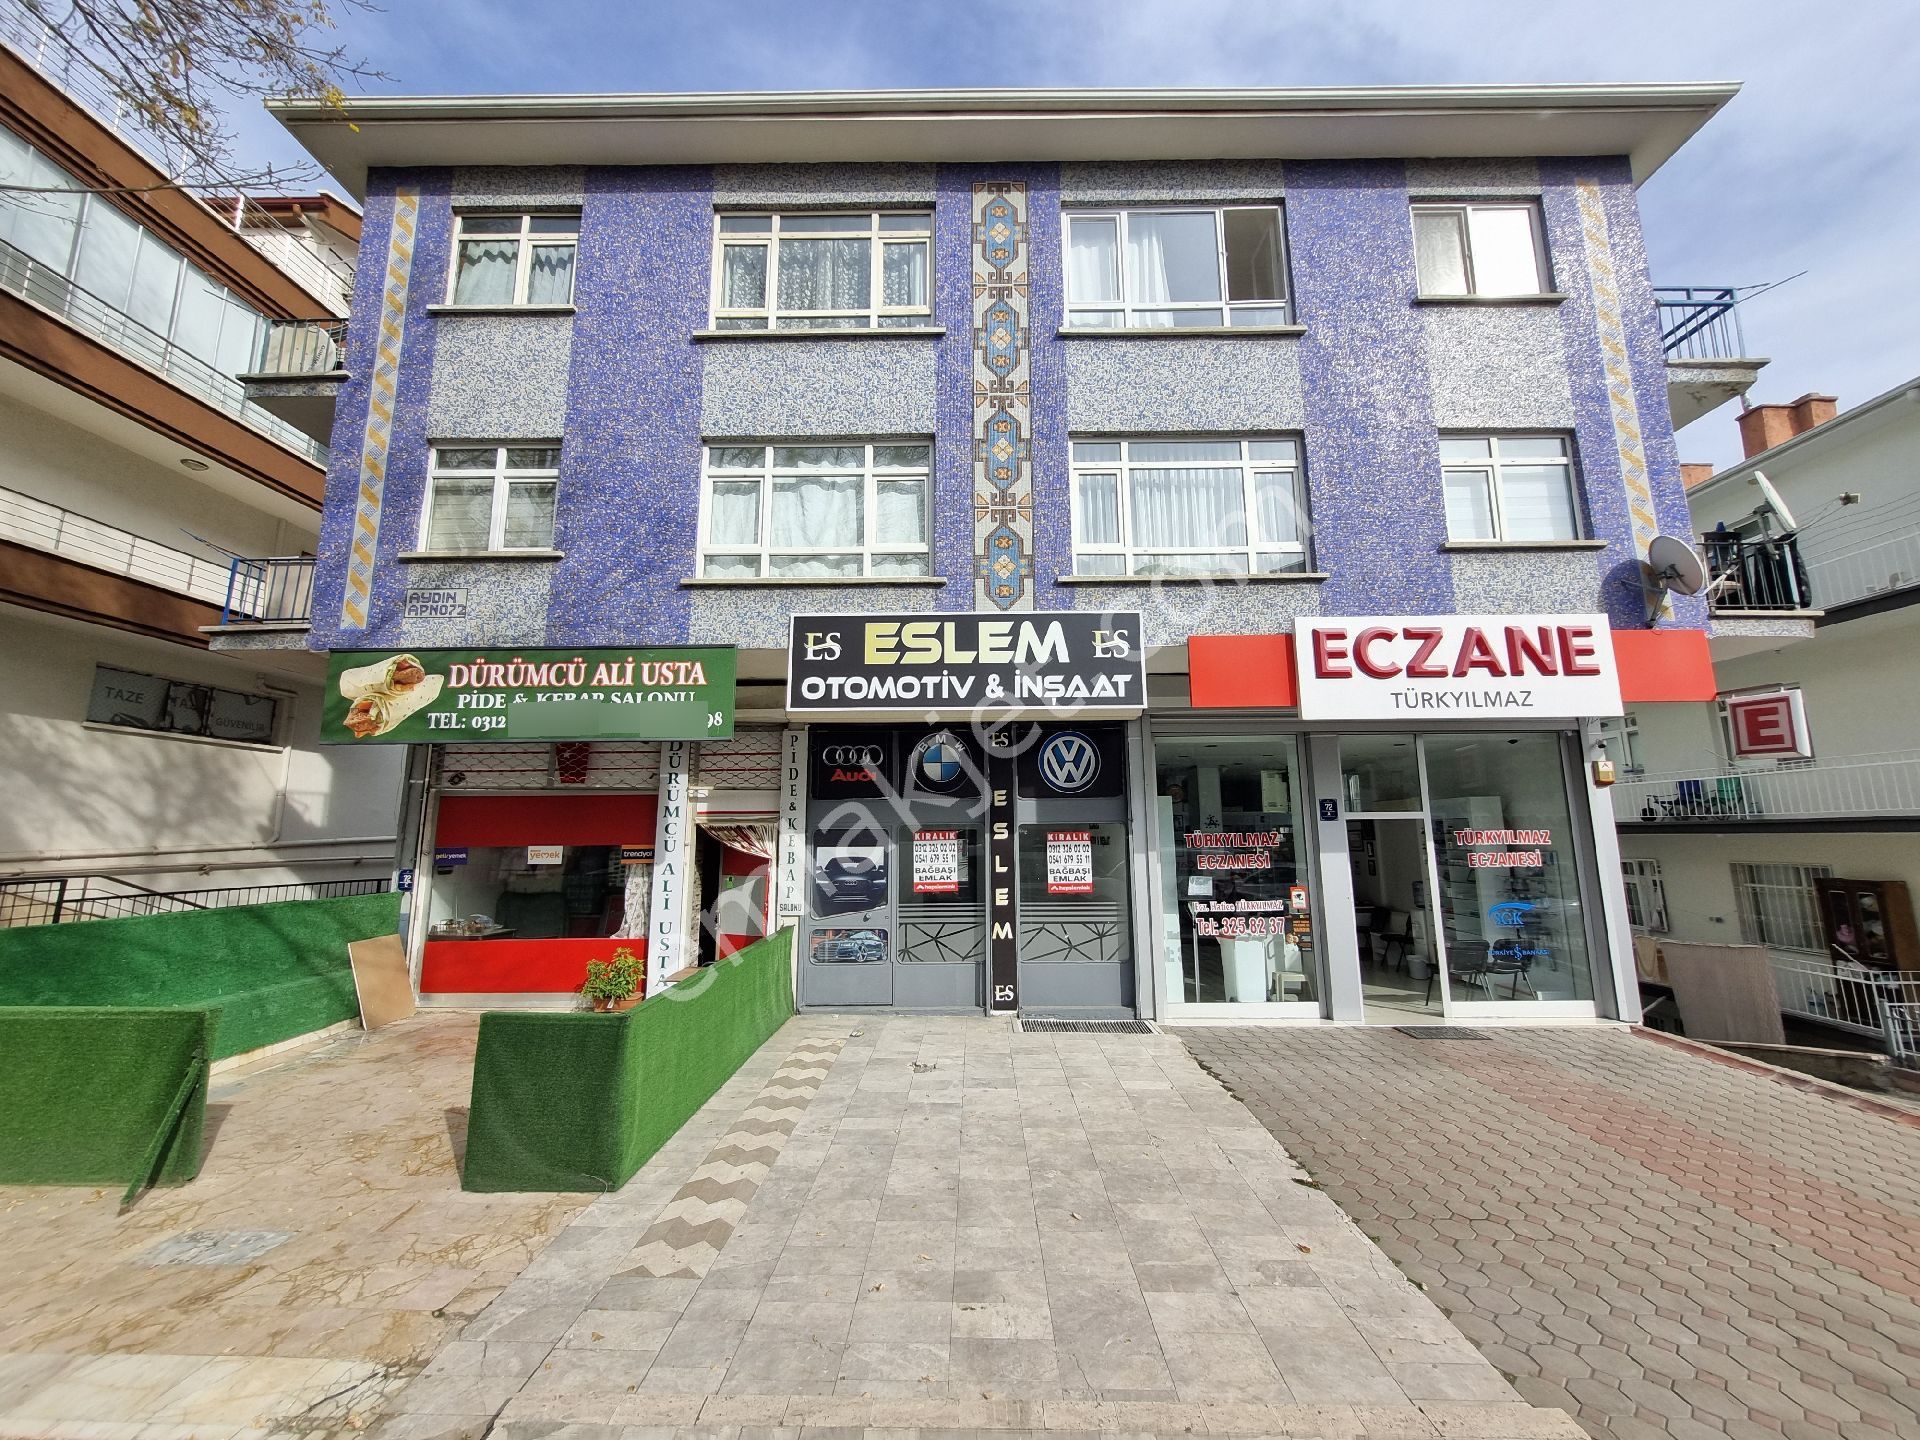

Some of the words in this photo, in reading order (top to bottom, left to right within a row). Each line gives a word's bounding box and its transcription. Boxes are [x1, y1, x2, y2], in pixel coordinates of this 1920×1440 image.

[408, 592, 457, 604] AYDIN
[804, 632, 842, 661] ES
[864, 620, 1070, 665] ESLEM
[1091, 629, 1132, 659] ES
[1311, 625, 1601, 680] ECZANE
[447, 656, 588, 688] DÜRÜMCÜ
[590, 656, 636, 687] ALİ
[640, 660, 708, 687] USTA
[105, 685, 145, 705] TAZE
[801, 669, 976, 700] OTOMOTİV
[985, 673, 1004, 699] &
[1014, 669, 1132, 706] İNŞAAT
[456, 689, 507, 709] PİDE
[1390, 687, 1534, 709] TÜRKYILMAZ
[427, 712, 466, 729] TEL:
[471, 714, 506, 732] 0312
[1743, 706, 1785, 747] E
[917, 733, 966, 753] BMW
[788, 734, 799, 797] PİDE
[830, 768, 877, 782] Audi
[662, 740, 684, 853] DÜRÜMCÜ
[788, 801, 797, 811] &
[1324, 803, 1333, 811] 72
[1183, 829, 1280, 849] TÜRKYILMAZ
[1453, 827, 1552, 846] TÜRKYILMAZ
[949, 843, 956, 852] 02
[786, 817, 798, 899] KEBAP
[991, 789, 1014, 940] ESLEM
[1197, 850, 1271, 870] ECZANESİ
[1467, 848, 1543, 868] ECZANESİ
[915, 865, 956, 875] BAĞBAŞI
[1049, 866, 1091, 876] BAĞBAŞI
[1053, 875, 1087, 883] EMLAK
[661, 862, 676, 910] ALİ
[1210, 900, 1235, 912] Hatice
[1195, 917, 1220, 936] Tel:
[1221, 916, 1247, 935] 325
[1248, 916, 1267, 935] 82
[1268, 916, 1285, 935] 37
[655, 921, 673, 987] USTA
